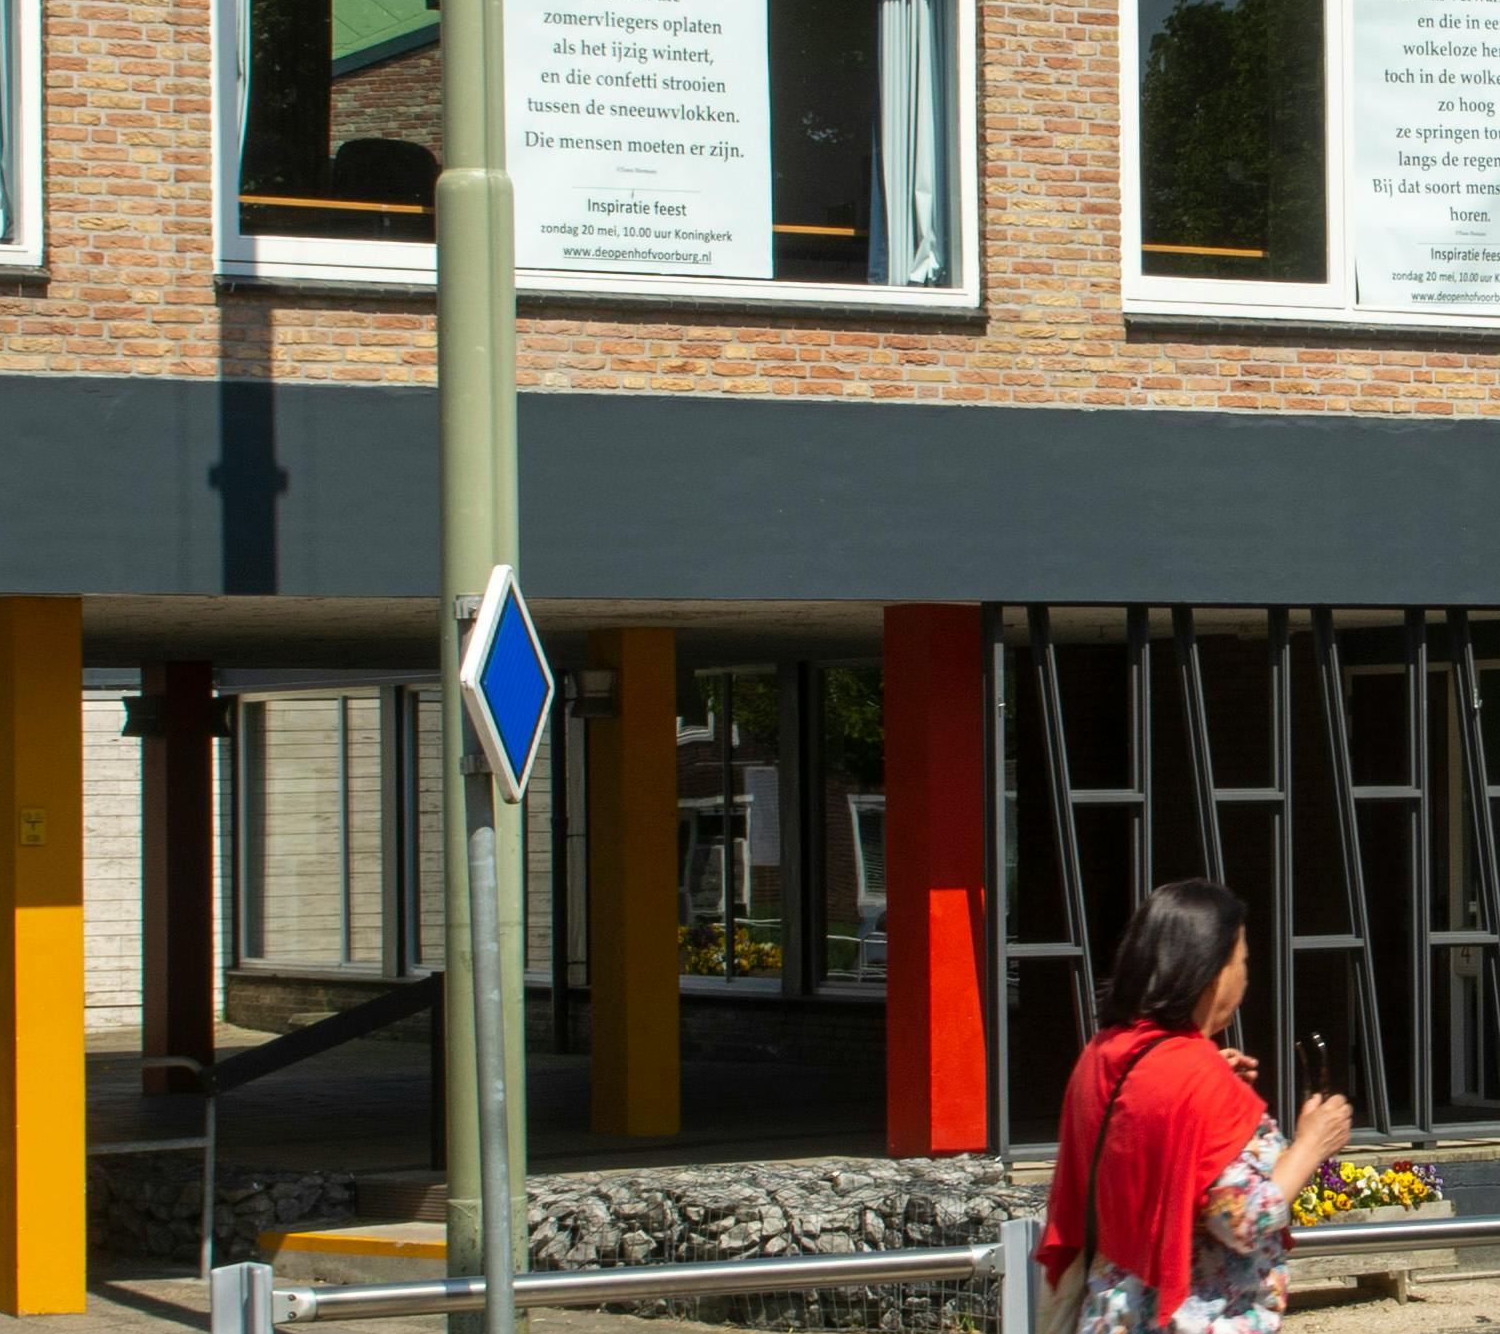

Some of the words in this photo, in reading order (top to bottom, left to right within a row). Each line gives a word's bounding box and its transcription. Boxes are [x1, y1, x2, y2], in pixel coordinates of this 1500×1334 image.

[544, 11, 658, 34] zomervliegers
[663, 16, 722, 37] oplaten
[1418, 18, 1434, 27] en
[1439, 14, 1461, 29] die
[1466, 14, 1480, 29] in
[553, 38, 576, 55] als
[581, 40, 606, 56] het
[612, 41, 648, 64] ijzig
[652, 45, 713, 65] wintert,
[1403, 41, 1477, 57] wolkeloze
[541, 72, 560, 83] en
[566, 68, 591, 85] die
[596, 71, 657, 89] confetti
[662, 76, 726, 93] strooien
[1385, 68, 1414, 83] toch
[1420, 69, 1433, 83] in
[1439, 69, 1455, 84] de
[528, 98, 580, 114] tussen
[586, 99, 605, 115] de
[610, 104, 739, 123] sneeuwvlokken.
[1438, 101, 1454, 111] zo
[1459, 97, 1495, 117] hoog
[1396, 128, 1411, 138] ze
[1416, 124, 1479, 144] springen
[525, 131, 554, 148] Die
[559, 138, 622, 151] mensen
[628, 140, 685, 155] moeten
[690, 144, 705, 155] er
[710, 141, 744, 162] zijn.
[1399, 151, 1437, 171] langs
[1442, 151, 1459, 167] de
[1373, 179, 1393, 197] Bij
[1398, 179, 1420, 193] dat
[1425, 181, 1461, 194] soort
[588, 198, 650, 215] Inspiratie
[654, 201, 686, 216] feest
[1450, 207, 1491, 222] horen.
[541, 223, 579, 237] zondag
[582, 225, 596, 235] 20
[597, 226, 620, 237] mei,
[623, 227, 651, 238] 10.00
[654, 231, 671, 239] uur
[675, 229, 732, 243] Koningkerk
[1431, 247, 1480, 263] Inspiratie
[1392, 271, 1424, 283] zondag
[1426, 271, 1437, 281] 20
[1439, 272, 1457, 283] mei,
[1459, 272, 1479, 282] 10.00
[1480, 274, 1493, 283] uur
